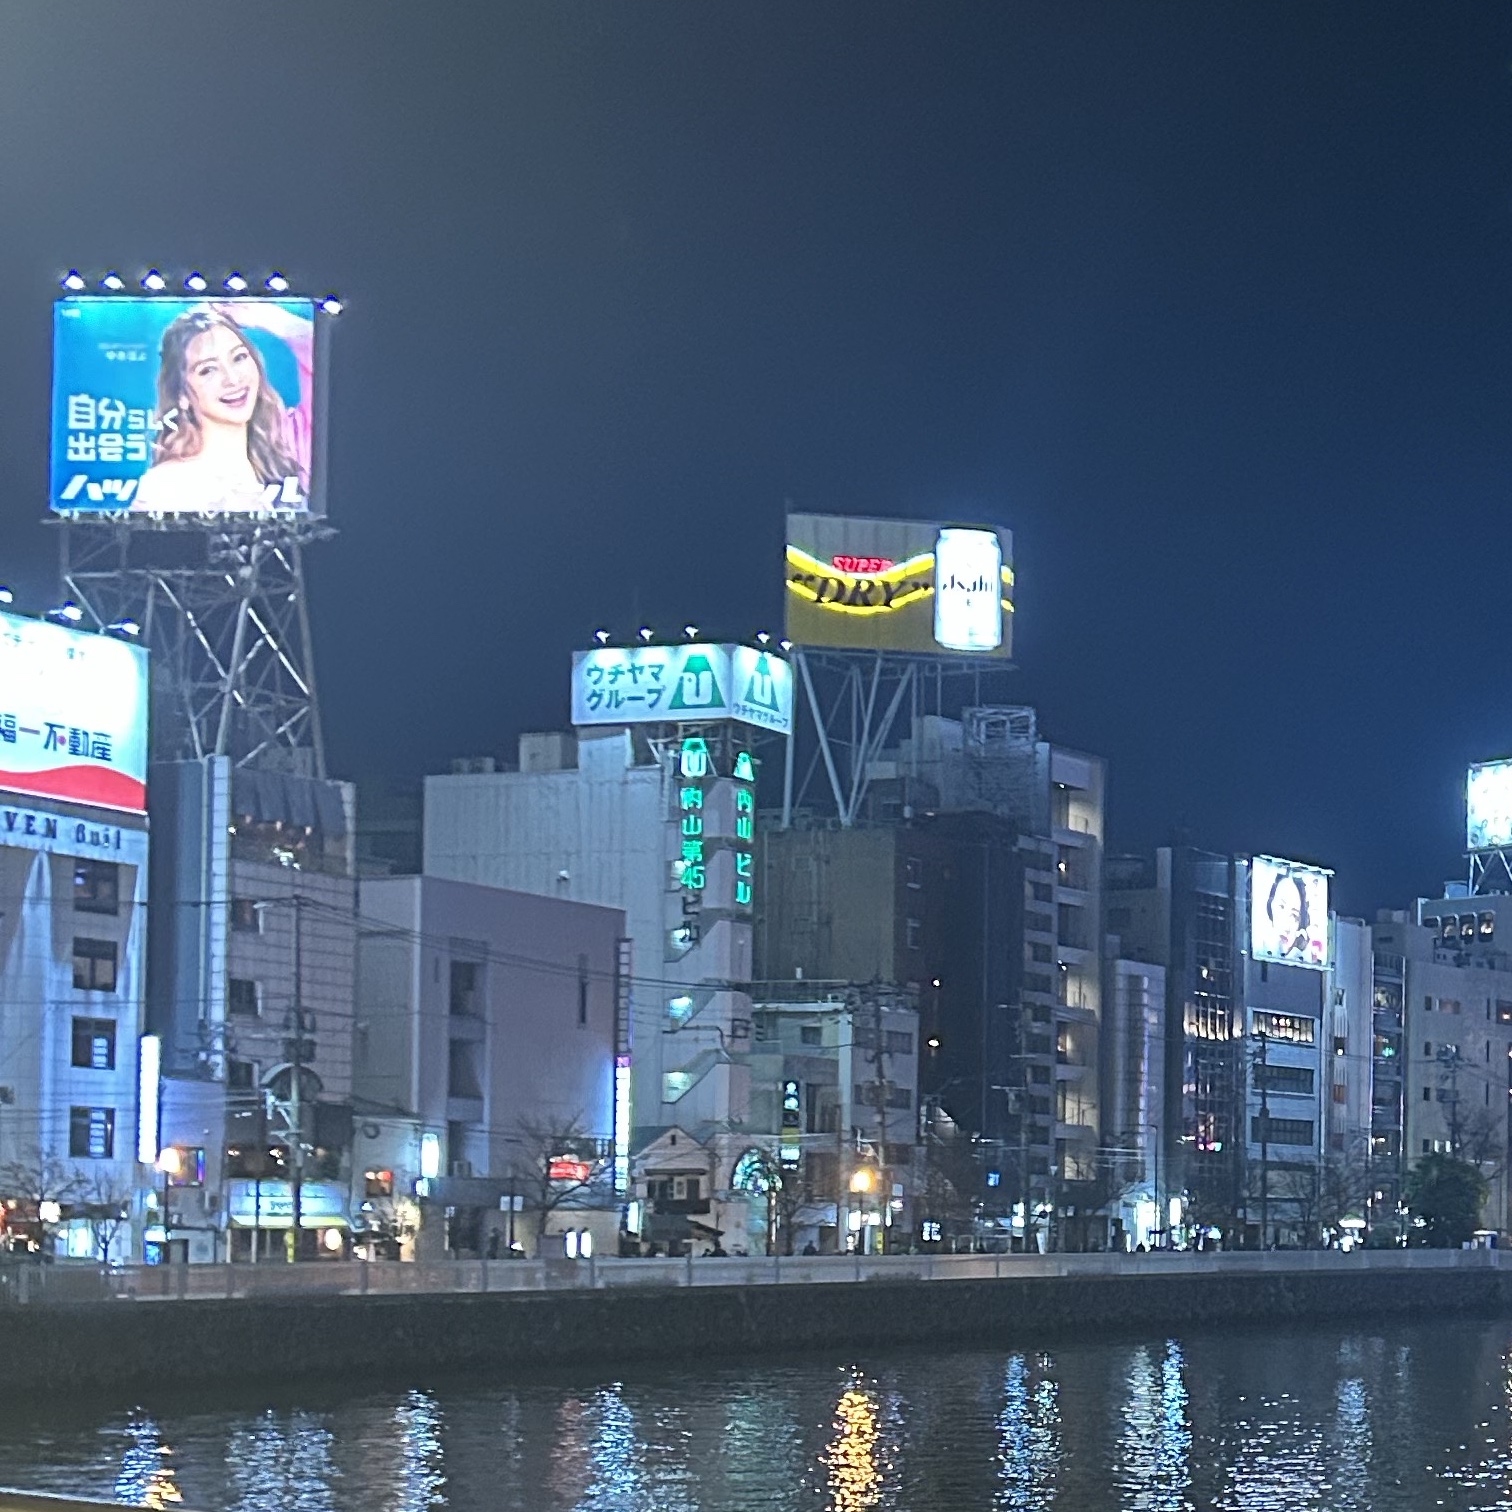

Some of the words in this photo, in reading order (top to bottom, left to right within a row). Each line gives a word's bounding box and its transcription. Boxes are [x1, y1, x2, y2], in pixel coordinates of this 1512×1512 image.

[832, 556, 895, 573] SUPER
[586, 663, 664, 685] ウチヤマ
[586, 685, 667, 711] グループ
[0, 713, 112, 762] 福一不動産
